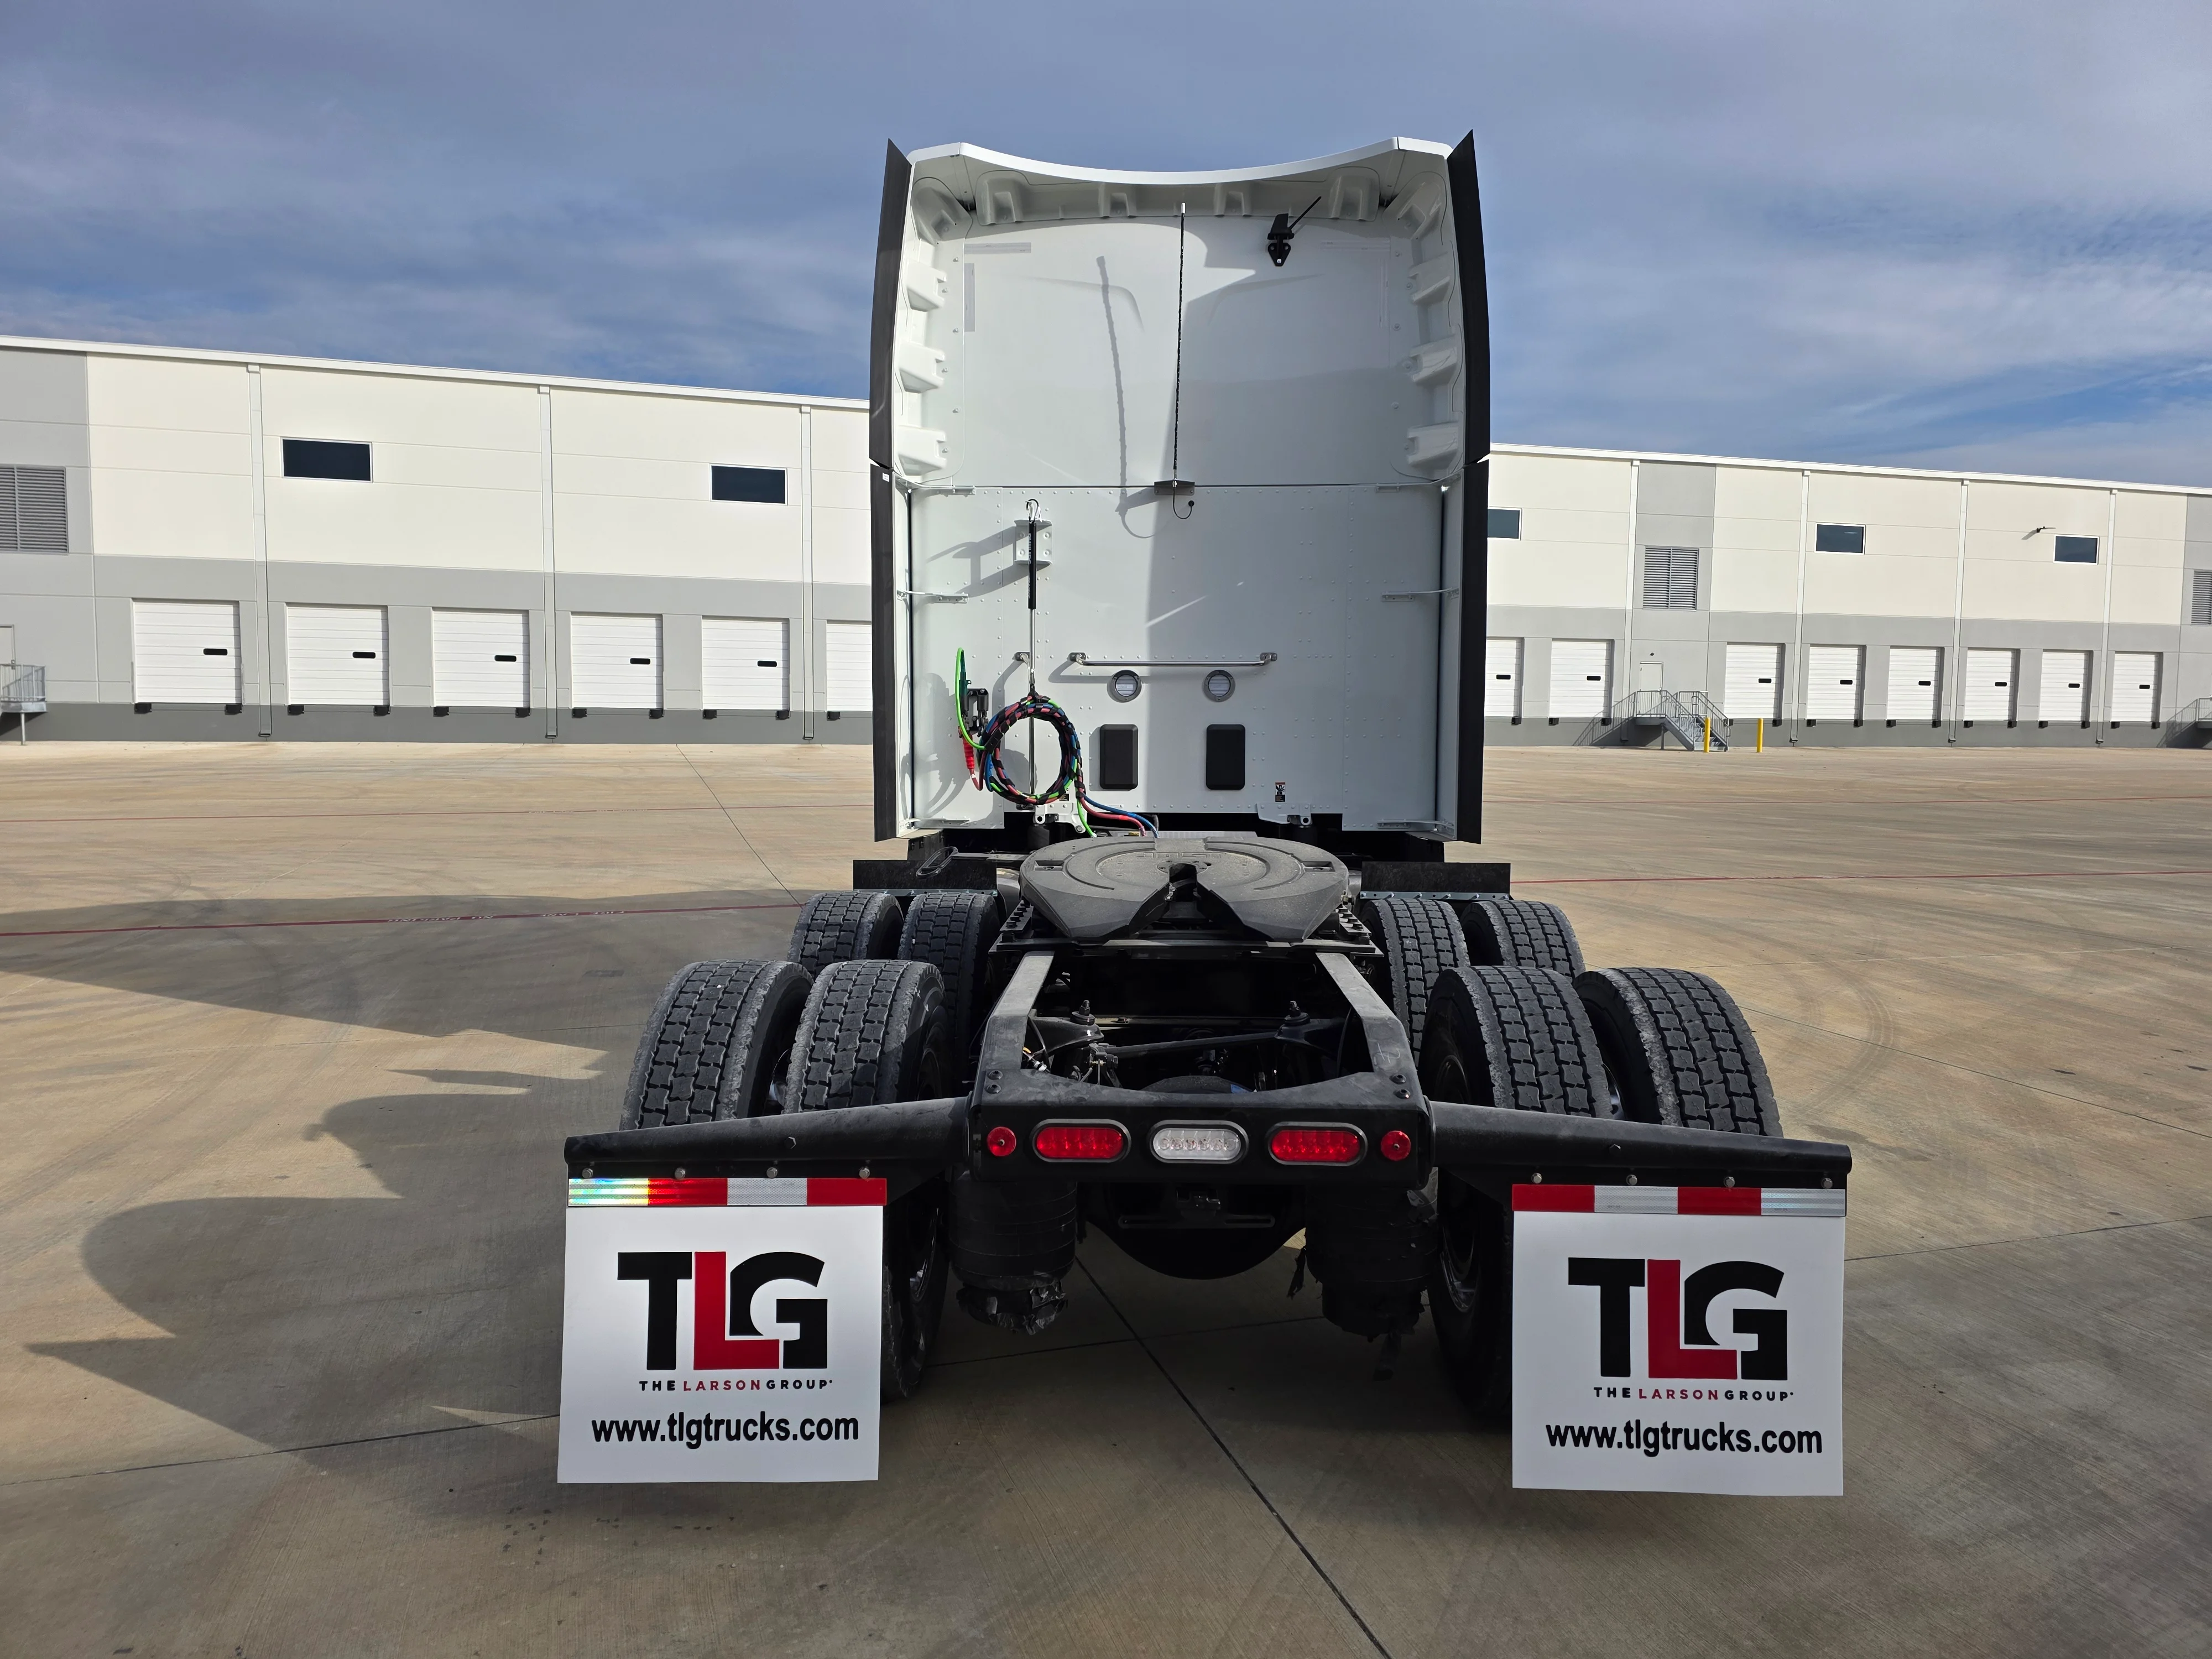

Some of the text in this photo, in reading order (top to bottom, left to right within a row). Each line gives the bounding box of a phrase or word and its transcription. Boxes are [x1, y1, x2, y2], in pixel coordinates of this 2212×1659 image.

[617, 1251, 827, 1370] TLG
[1568, 1258, 1787, 1380] TLG
[639, 1380, 827, 1391] THE LARSON GROUP
[1594, 1387, 1788, 1401] THE LARSON GROUP
[592, 1411, 858, 1449] www.tlgtrucks.com
[1546, 1420, 1822, 1457] www.tlgtrucks.com
